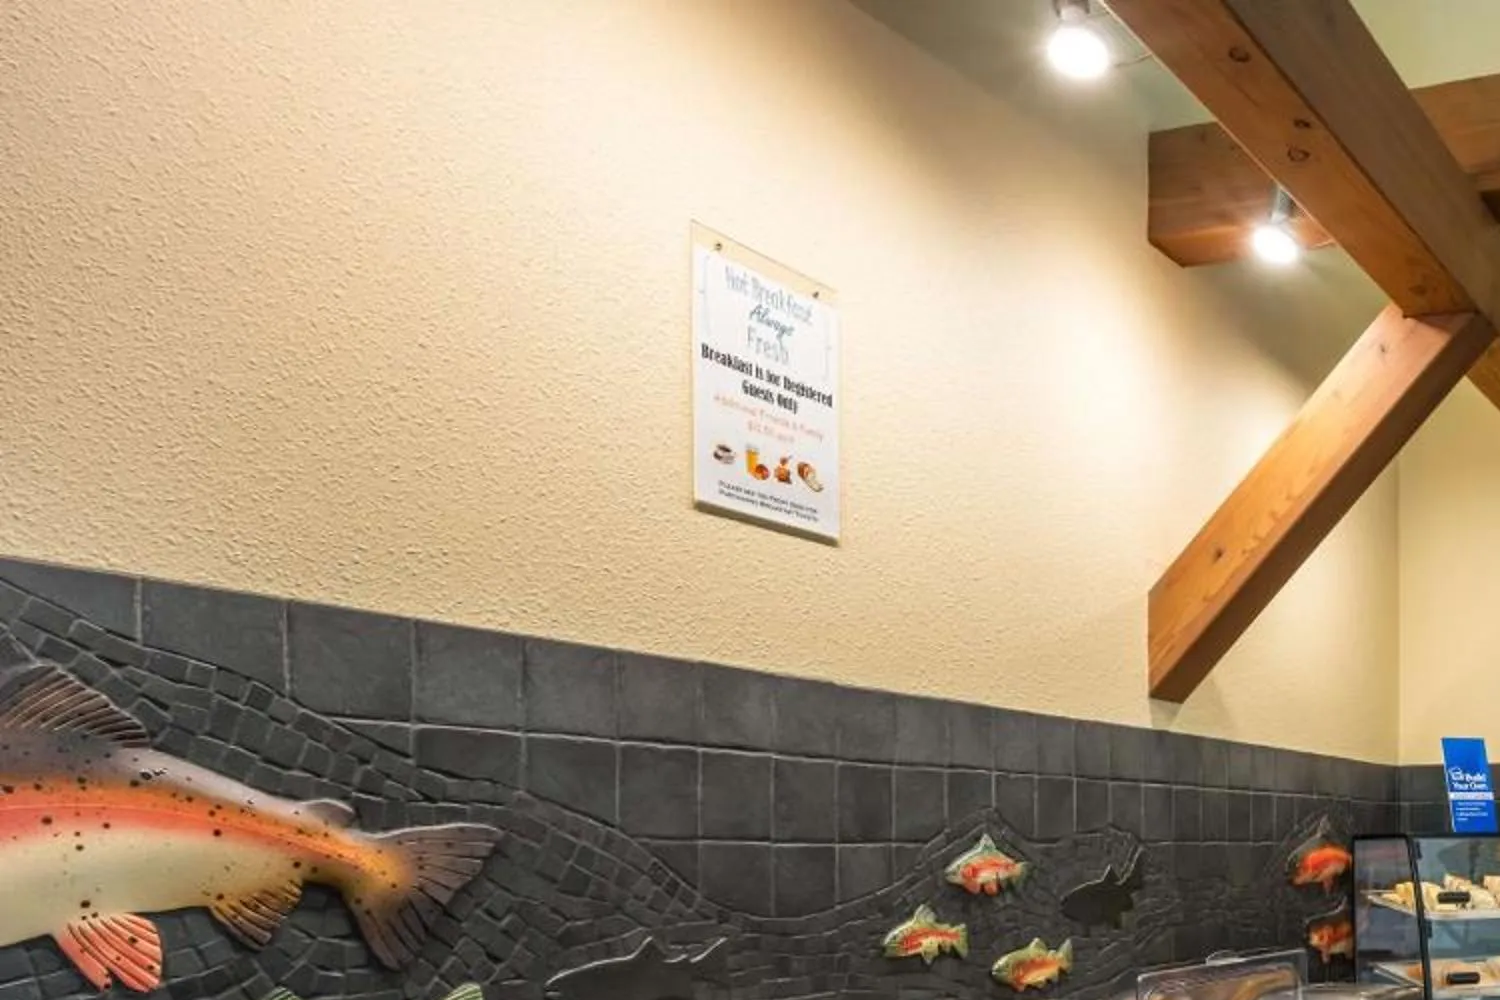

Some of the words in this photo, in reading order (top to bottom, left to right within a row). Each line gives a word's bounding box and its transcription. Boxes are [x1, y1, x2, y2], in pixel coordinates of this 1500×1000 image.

[701, 342, 753, 377] Breakfast
[783, 375, 833, 409] Registered
[742, 379, 774, 405] Guests
